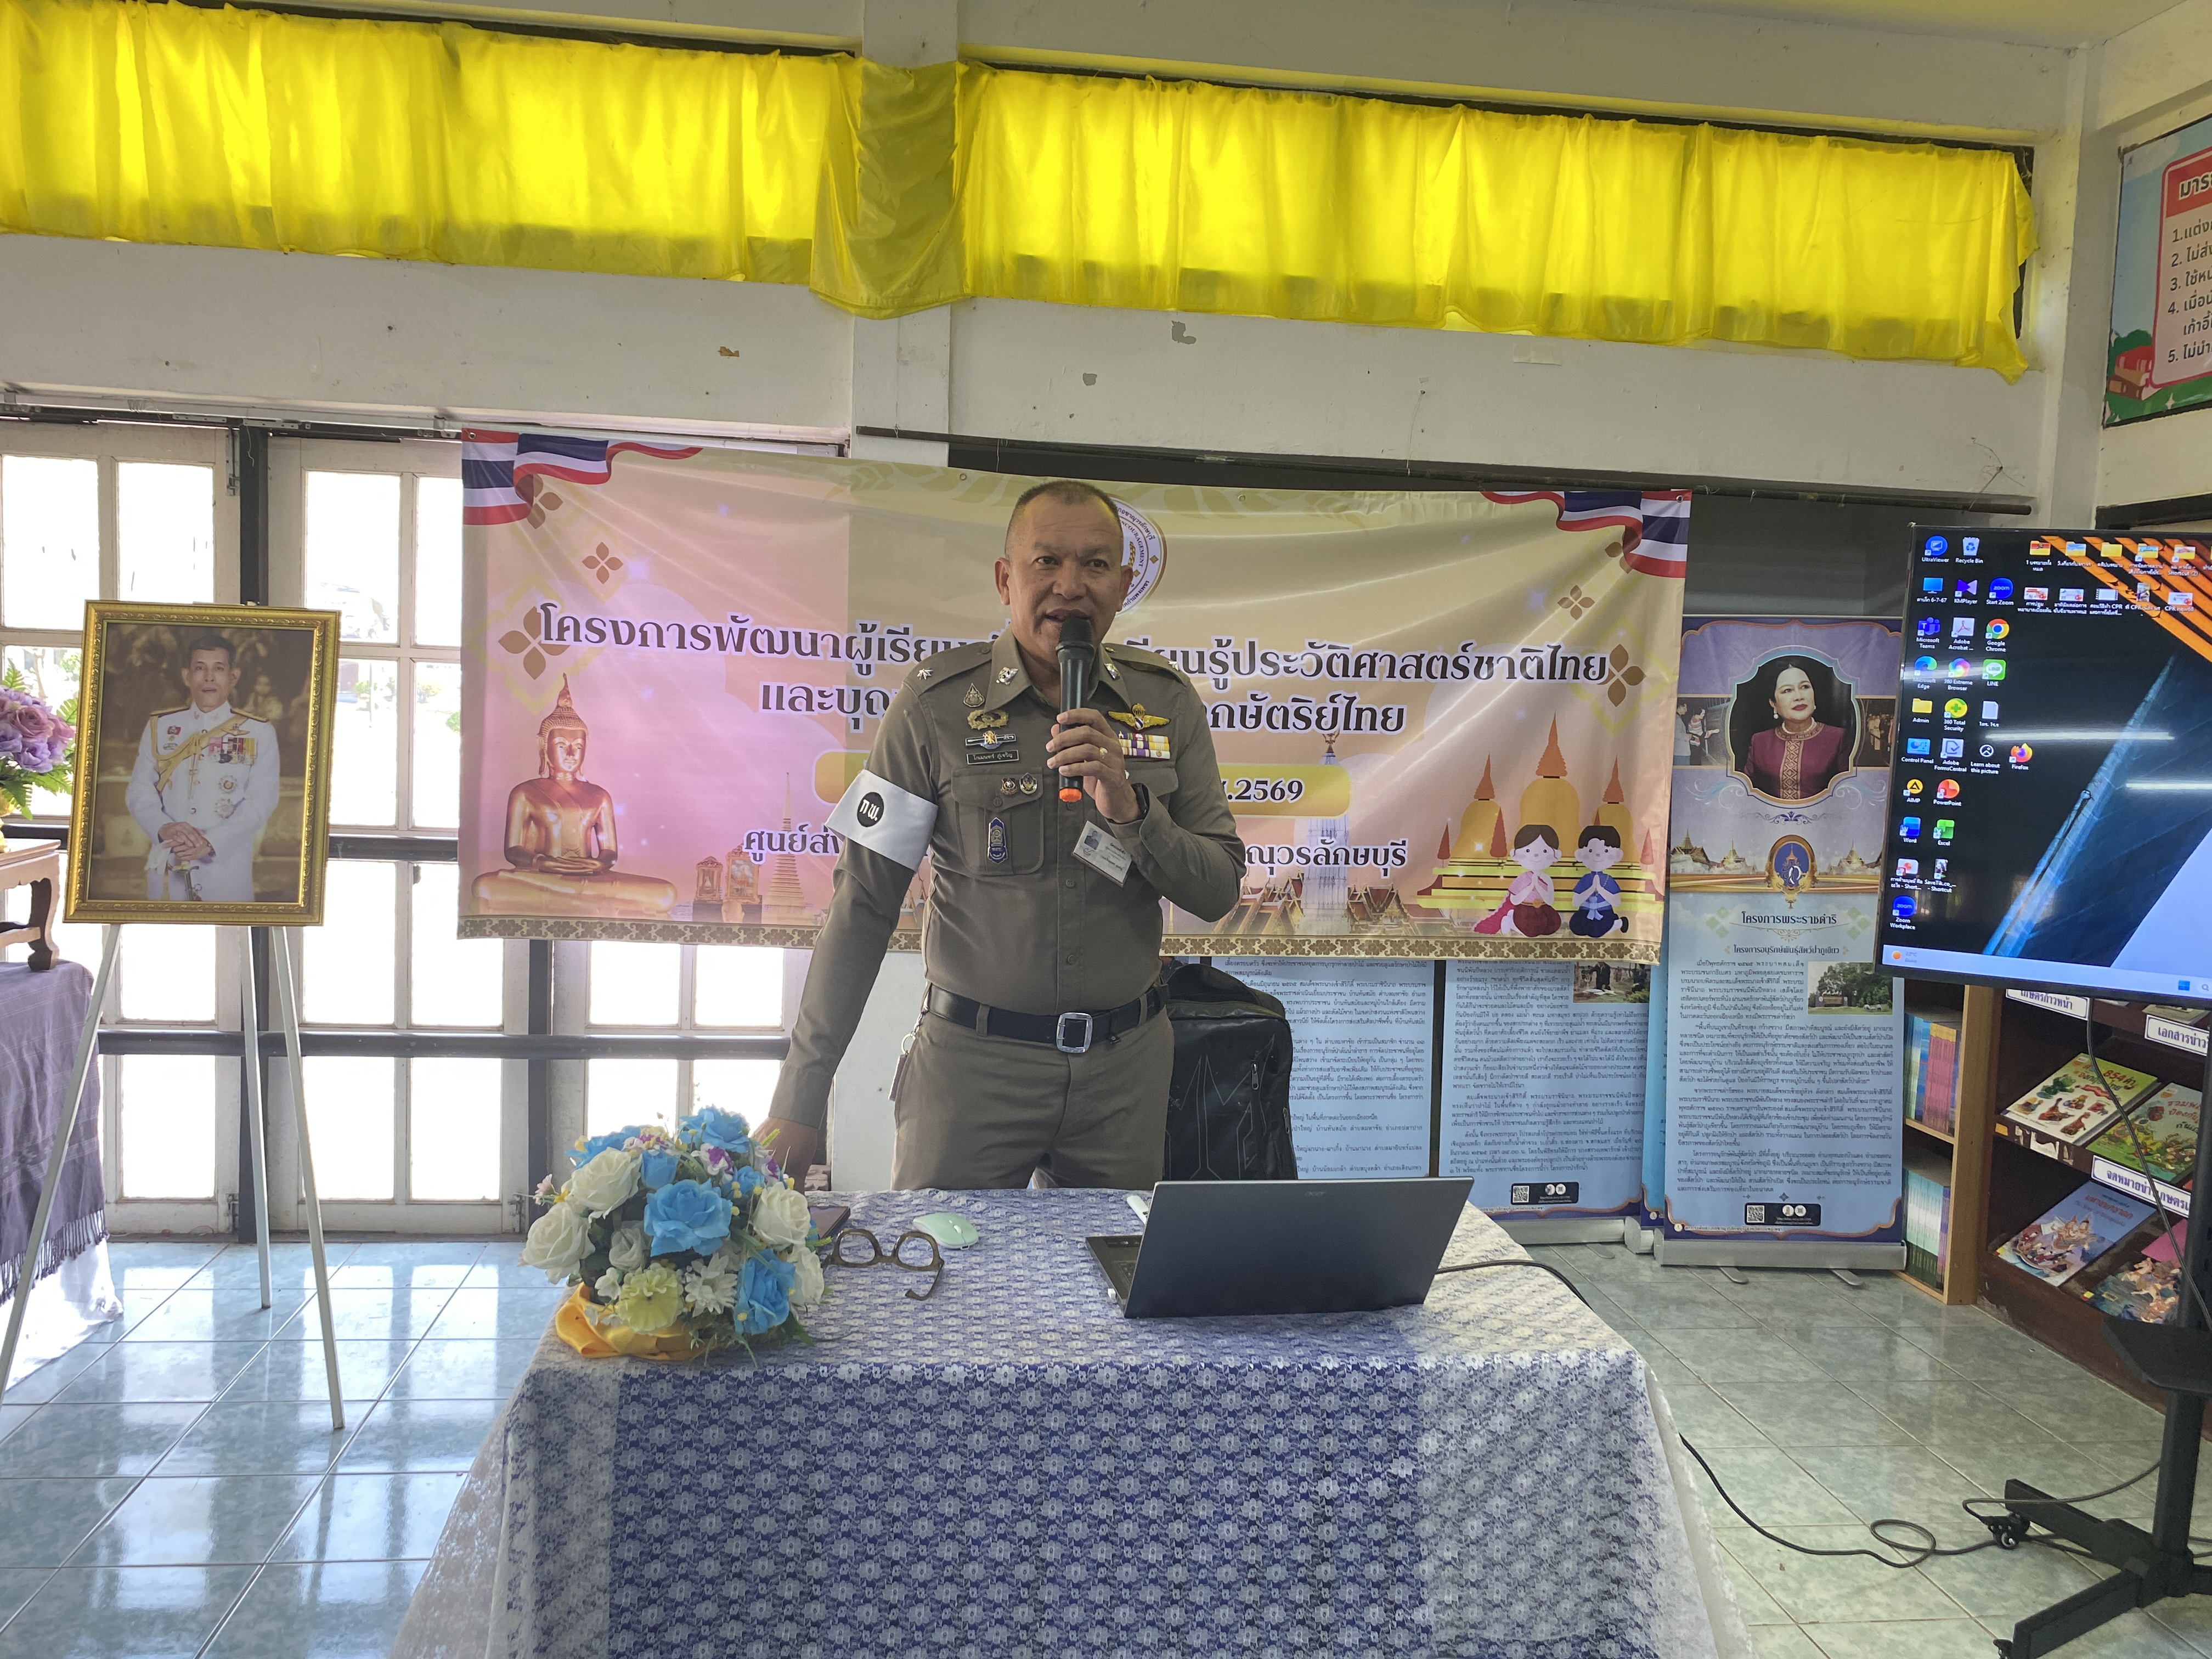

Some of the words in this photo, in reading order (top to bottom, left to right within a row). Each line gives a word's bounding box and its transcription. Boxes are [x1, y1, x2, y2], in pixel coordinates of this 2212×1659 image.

[2180, 173, 2212, 198] มาร
[2172, 218, 2212, 242] 1.แต่ง
[2171, 253, 2182, 267] 2.
[2170, 277, 2181, 291] 3.
[2168, 301, 2179, 314] 4.
[2183, 310, 2212, 335] เก้าอี้
[2168, 349, 2179, 363] 5.
[2183, 340, 2212, 359] ไม่นำ
[541, 604, 967, 676] โครงการพัฒนาผู้เรีย
[1203, 693, 1404, 732] กษัตริย์ไทย
[1223, 780, 1303, 801] .2569
[2158, 1026, 2209, 1049] เอกสารข่าว
